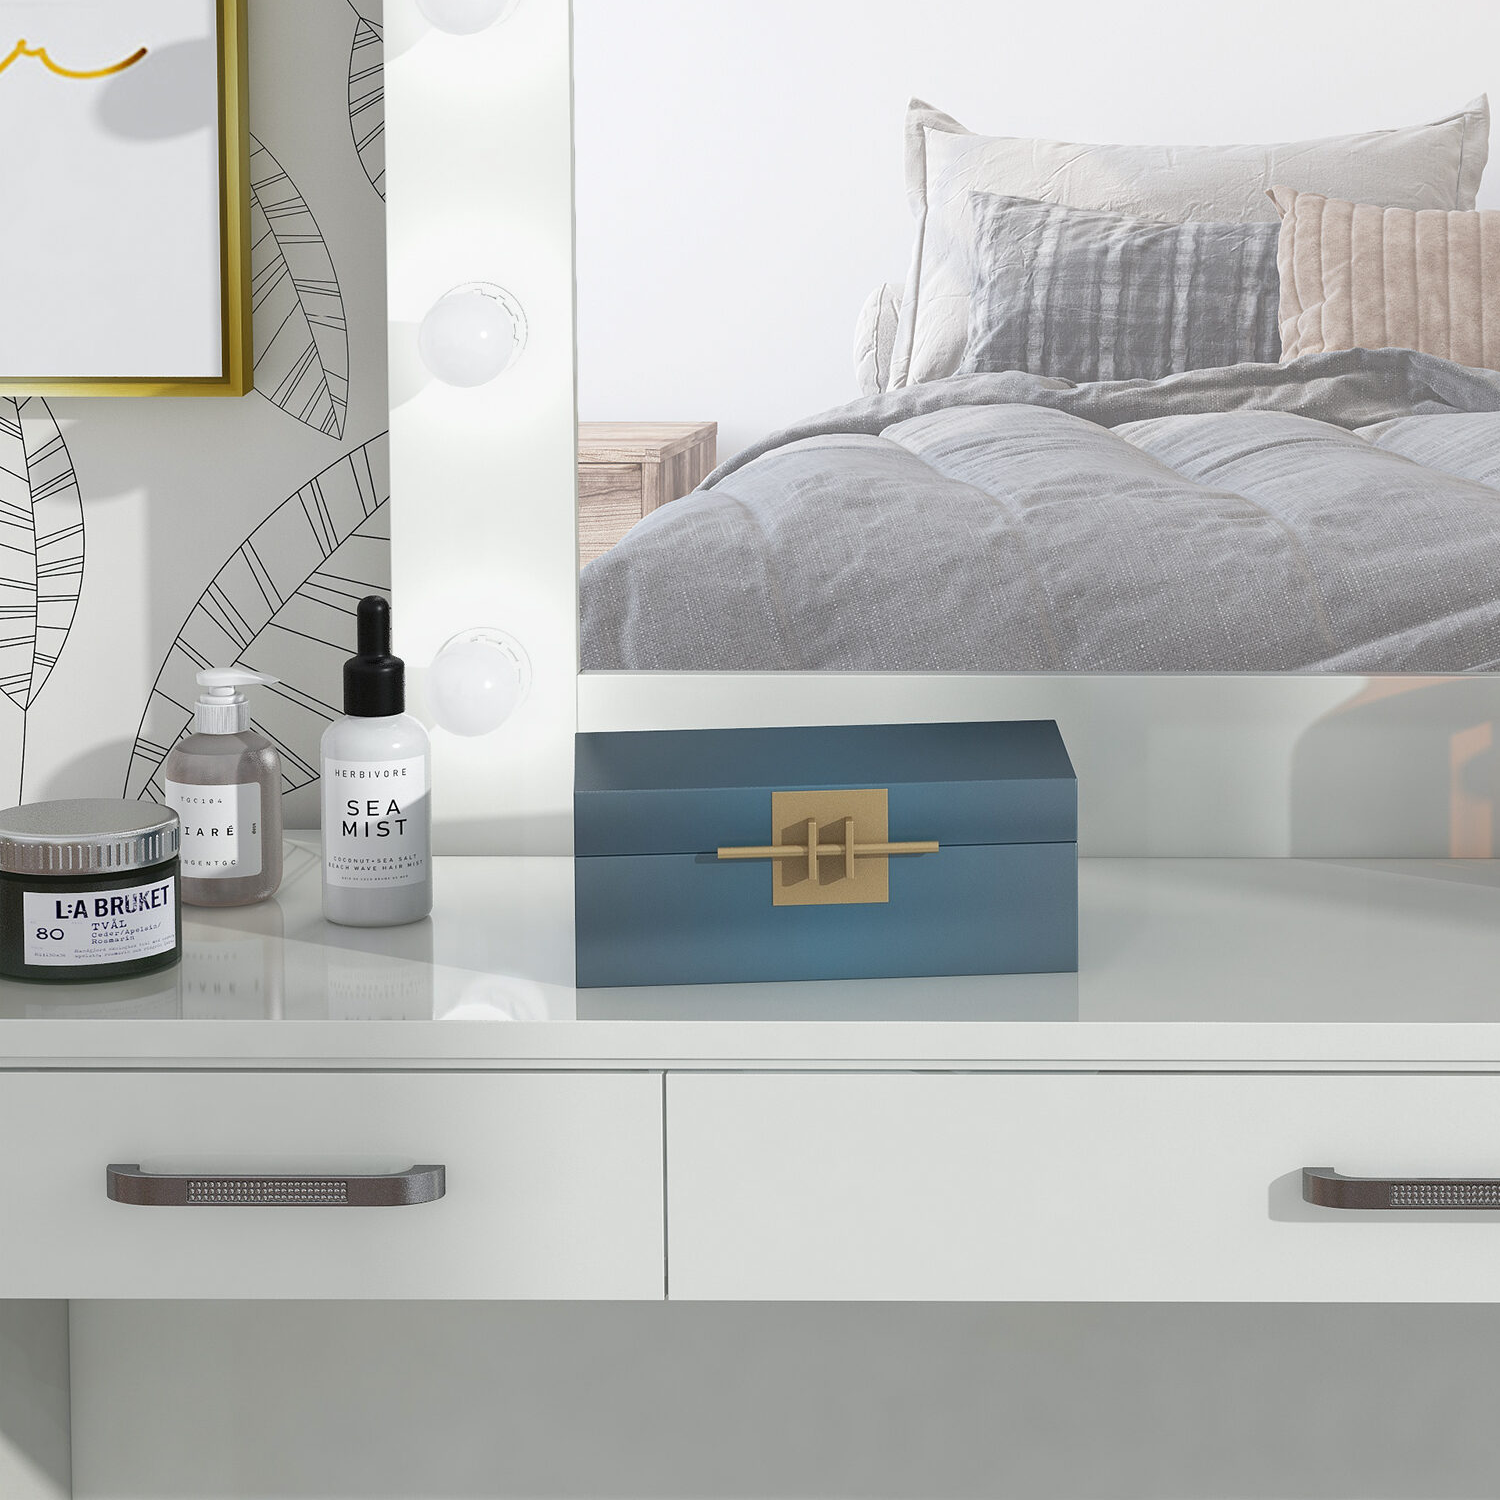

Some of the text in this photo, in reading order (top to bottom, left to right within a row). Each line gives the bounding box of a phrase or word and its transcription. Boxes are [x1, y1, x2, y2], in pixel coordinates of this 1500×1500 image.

[335, 768, 407, 778] HERBIVORE
[346, 799, 401, 816] SEA
[342, 819, 407, 837] MIST
[94, 885, 170, 918] BRUKET
[91, 918, 127, 931] TVÅL
[36, 927, 65, 940] 80
[91, 935, 135, 945] Rosmarin
